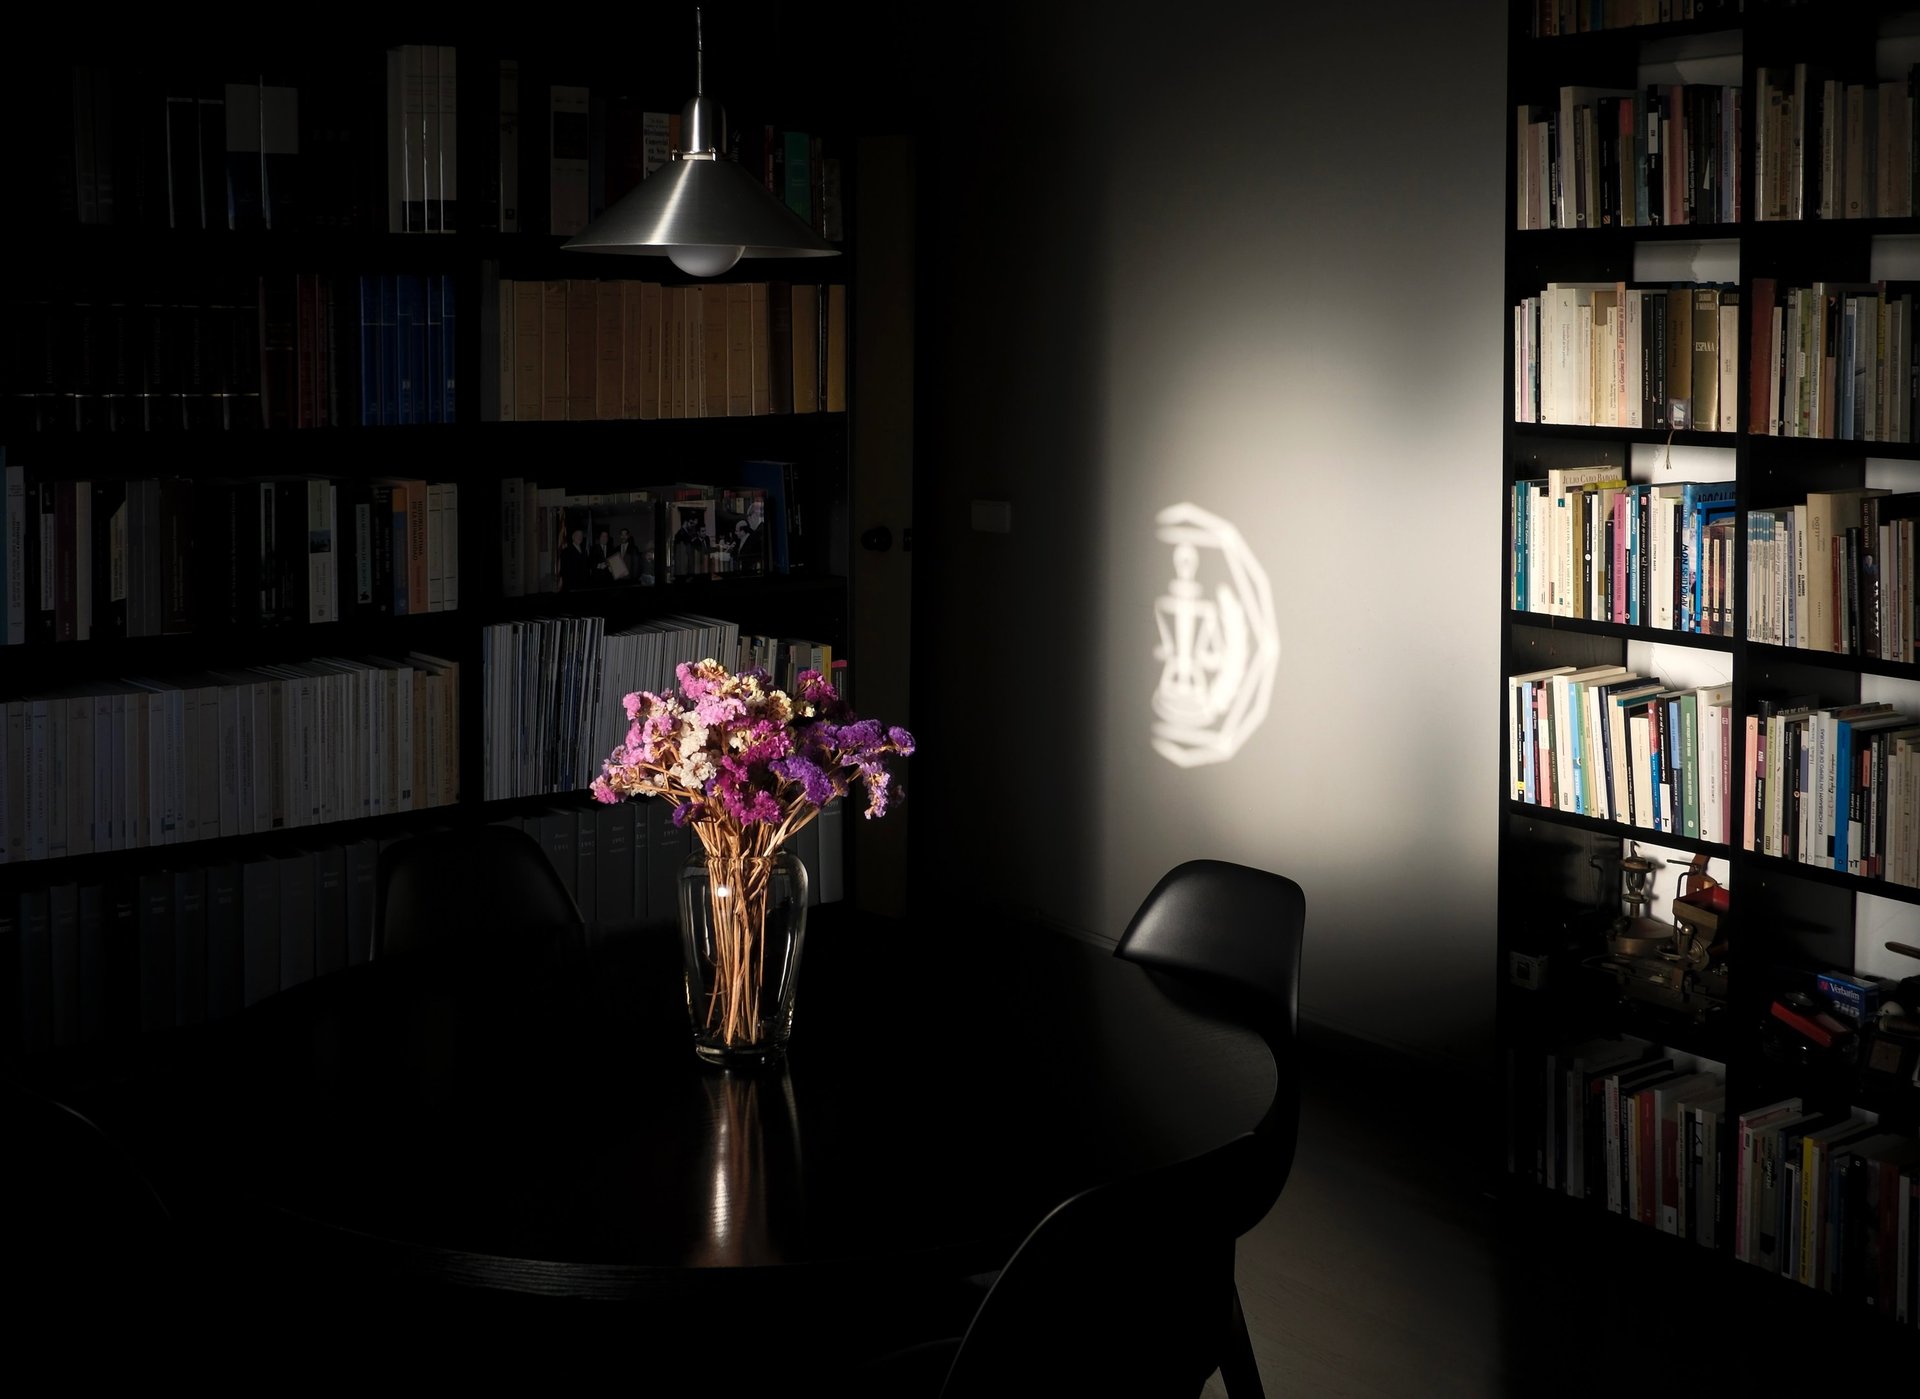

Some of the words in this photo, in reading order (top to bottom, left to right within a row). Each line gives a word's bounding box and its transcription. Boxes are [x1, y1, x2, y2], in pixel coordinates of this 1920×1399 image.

[1695, 341, 1715, 352] ESPAÑA
[1580, 474, 1596, 483] CARO
[1818, 756, 1824, 764] DE
[1829, 983, 1860, 1001] Verbatim
